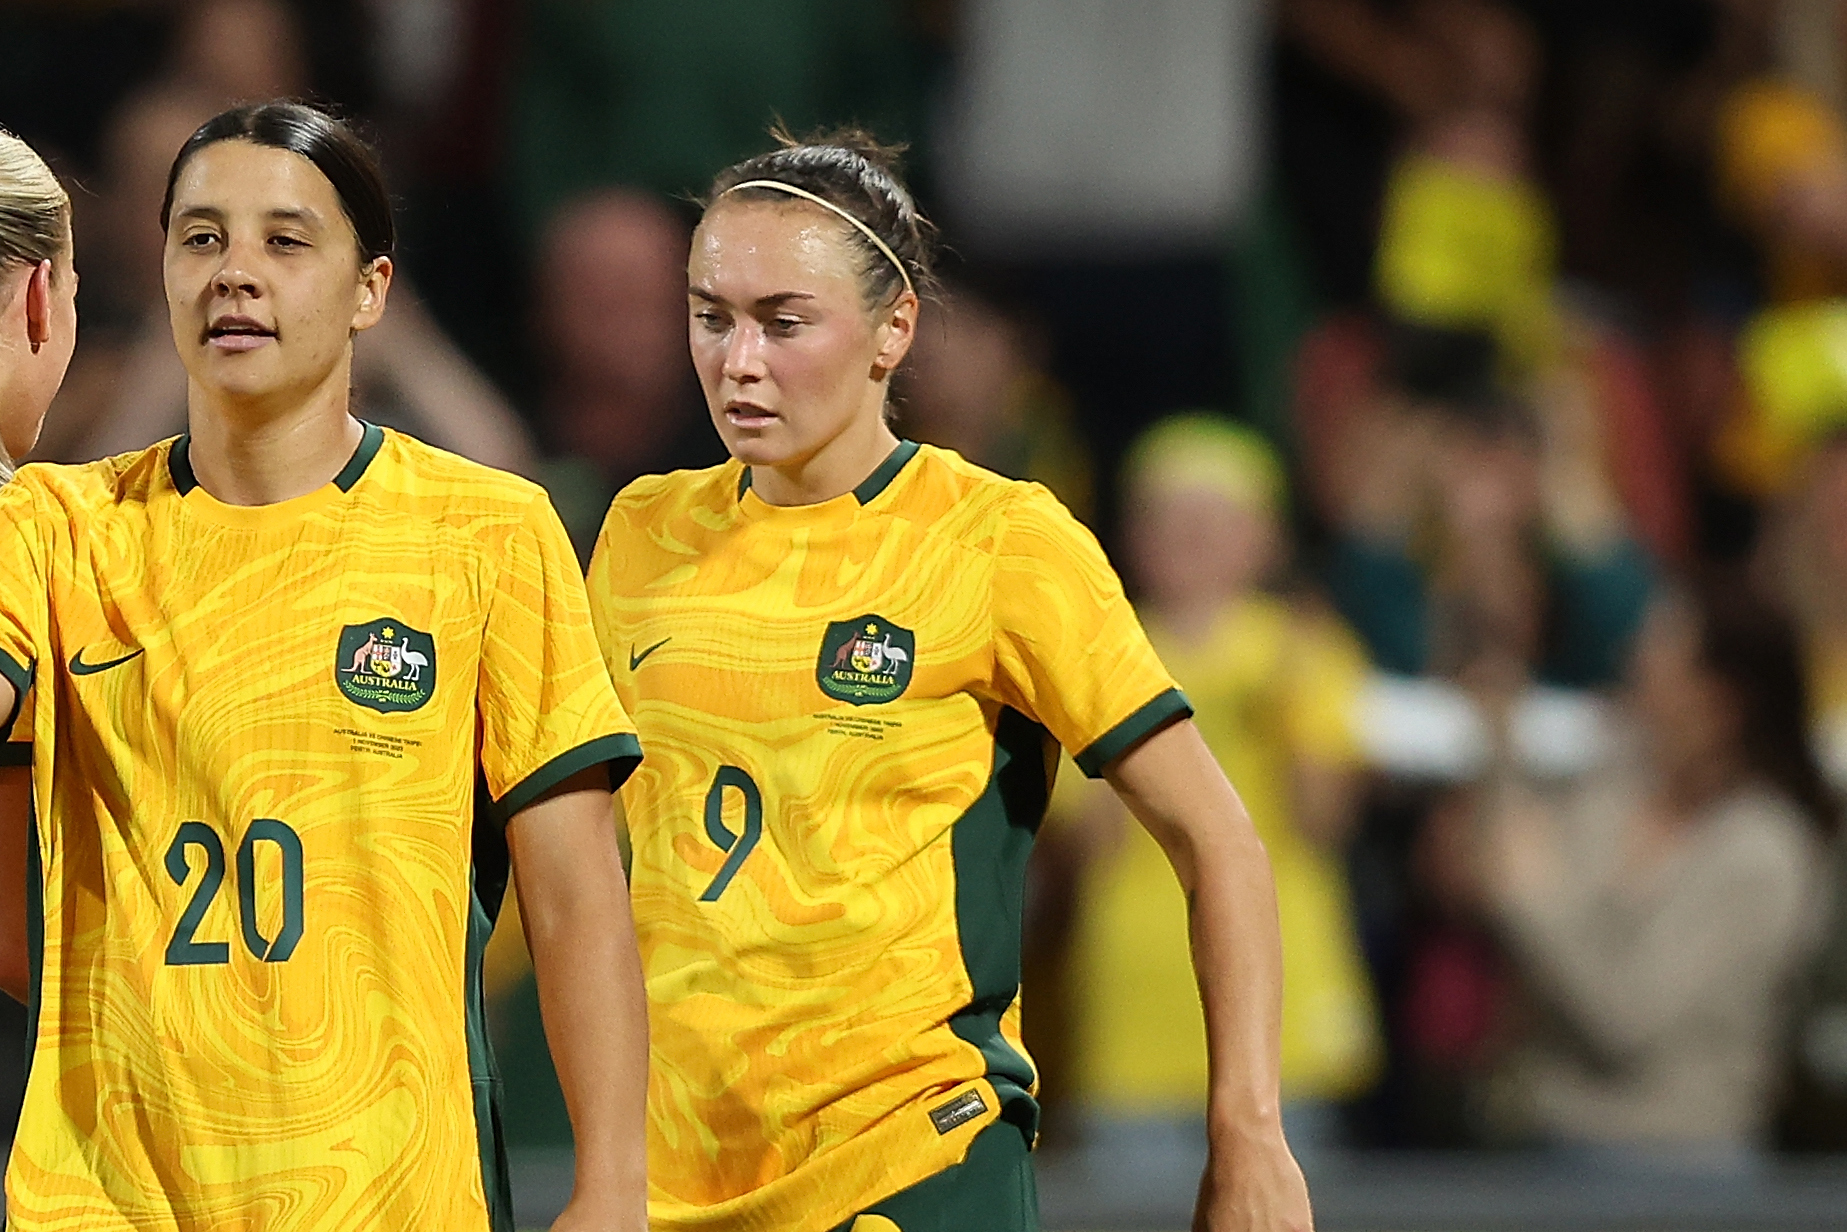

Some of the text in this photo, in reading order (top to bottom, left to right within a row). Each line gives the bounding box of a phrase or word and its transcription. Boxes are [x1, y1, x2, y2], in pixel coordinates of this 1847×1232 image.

[352, 674, 418, 691] AUSTRALIA
[832, 669, 895, 685] AUSTRALIA
[696, 764, 763, 902] 9
[163, 818, 305, 966] 20
